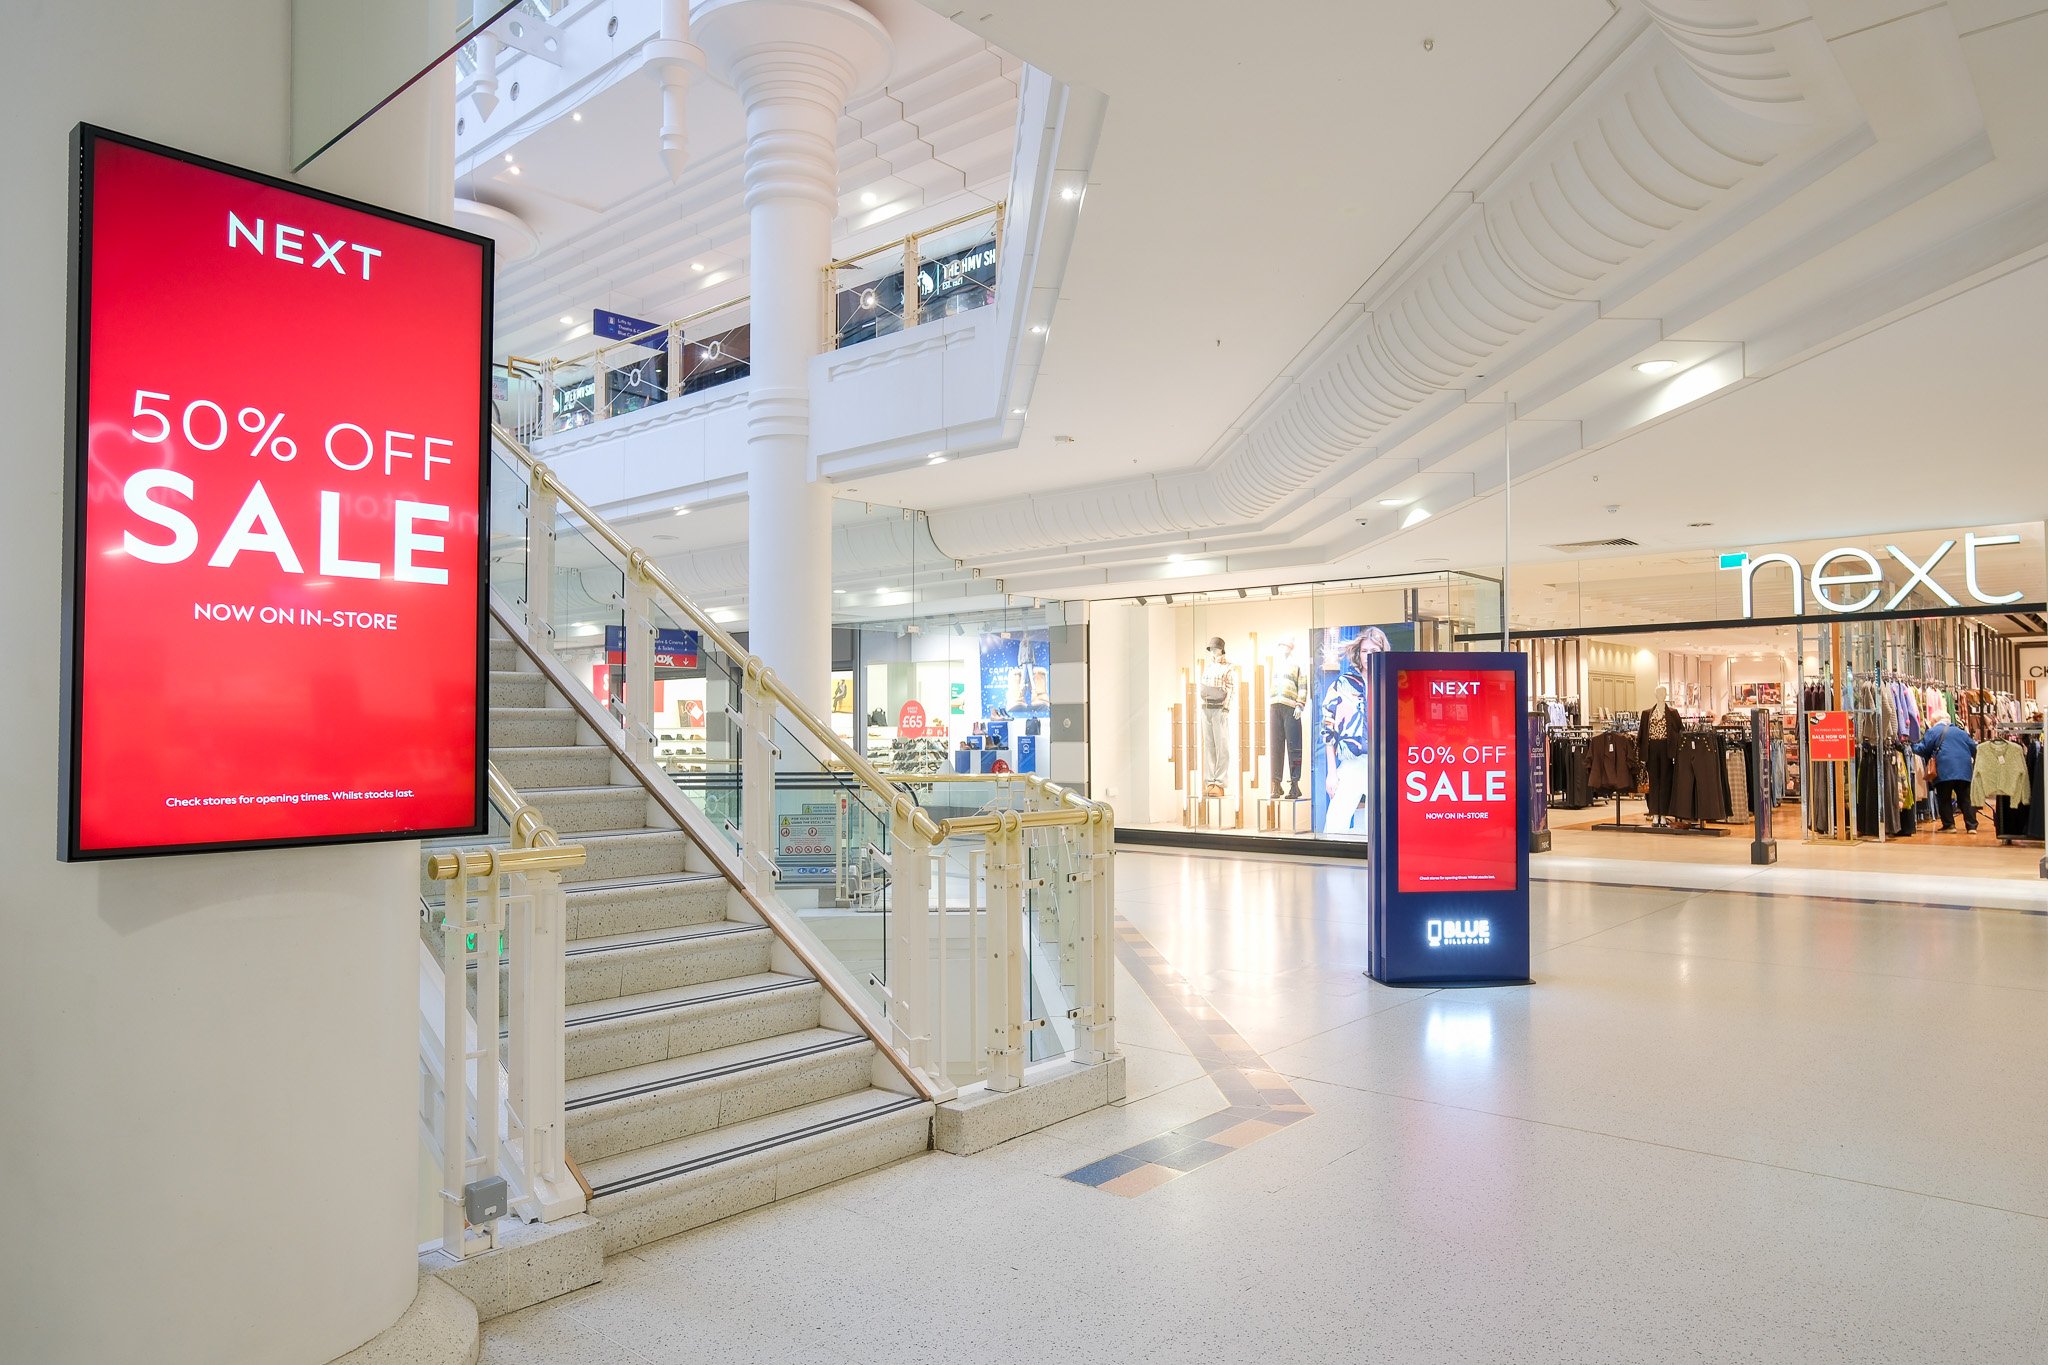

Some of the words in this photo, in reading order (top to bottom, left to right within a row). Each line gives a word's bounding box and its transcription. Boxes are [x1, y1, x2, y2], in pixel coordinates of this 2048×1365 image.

[228, 210, 382, 281] NEXT
[961, 252, 982, 273] HMV
[131, 390, 298, 461] 50%
[325, 423, 453, 480] OFF
[123, 468, 450, 585] SALE
[1739, 532, 2024, 619] next
[194, 602, 255, 622] NOW
[259, 606, 294, 625] ON
[300, 609, 398, 630] IN-STORE
[1432, 681, 1480, 695] NEXT
[902, 715, 923, 729] £65
[1407, 746, 1456, 764] 50%
[1462, 746, 1507, 764] OFF
[1406, 770, 1507, 802] SALE
[165, 797, 201, 808] Check
[203, 796, 237, 806] stores
[238, 794, 255, 804] for
[256, 793, 299, 805] opening
[300, 792, 331, 802] times.
[332, 791, 363, 800] Whilst
[364, 789, 394, 800] stocks
[395, 789, 415, 798] last.
[1425, 812, 1444, 820] NOW
[1443, 919, 1490, 938] BLUE
